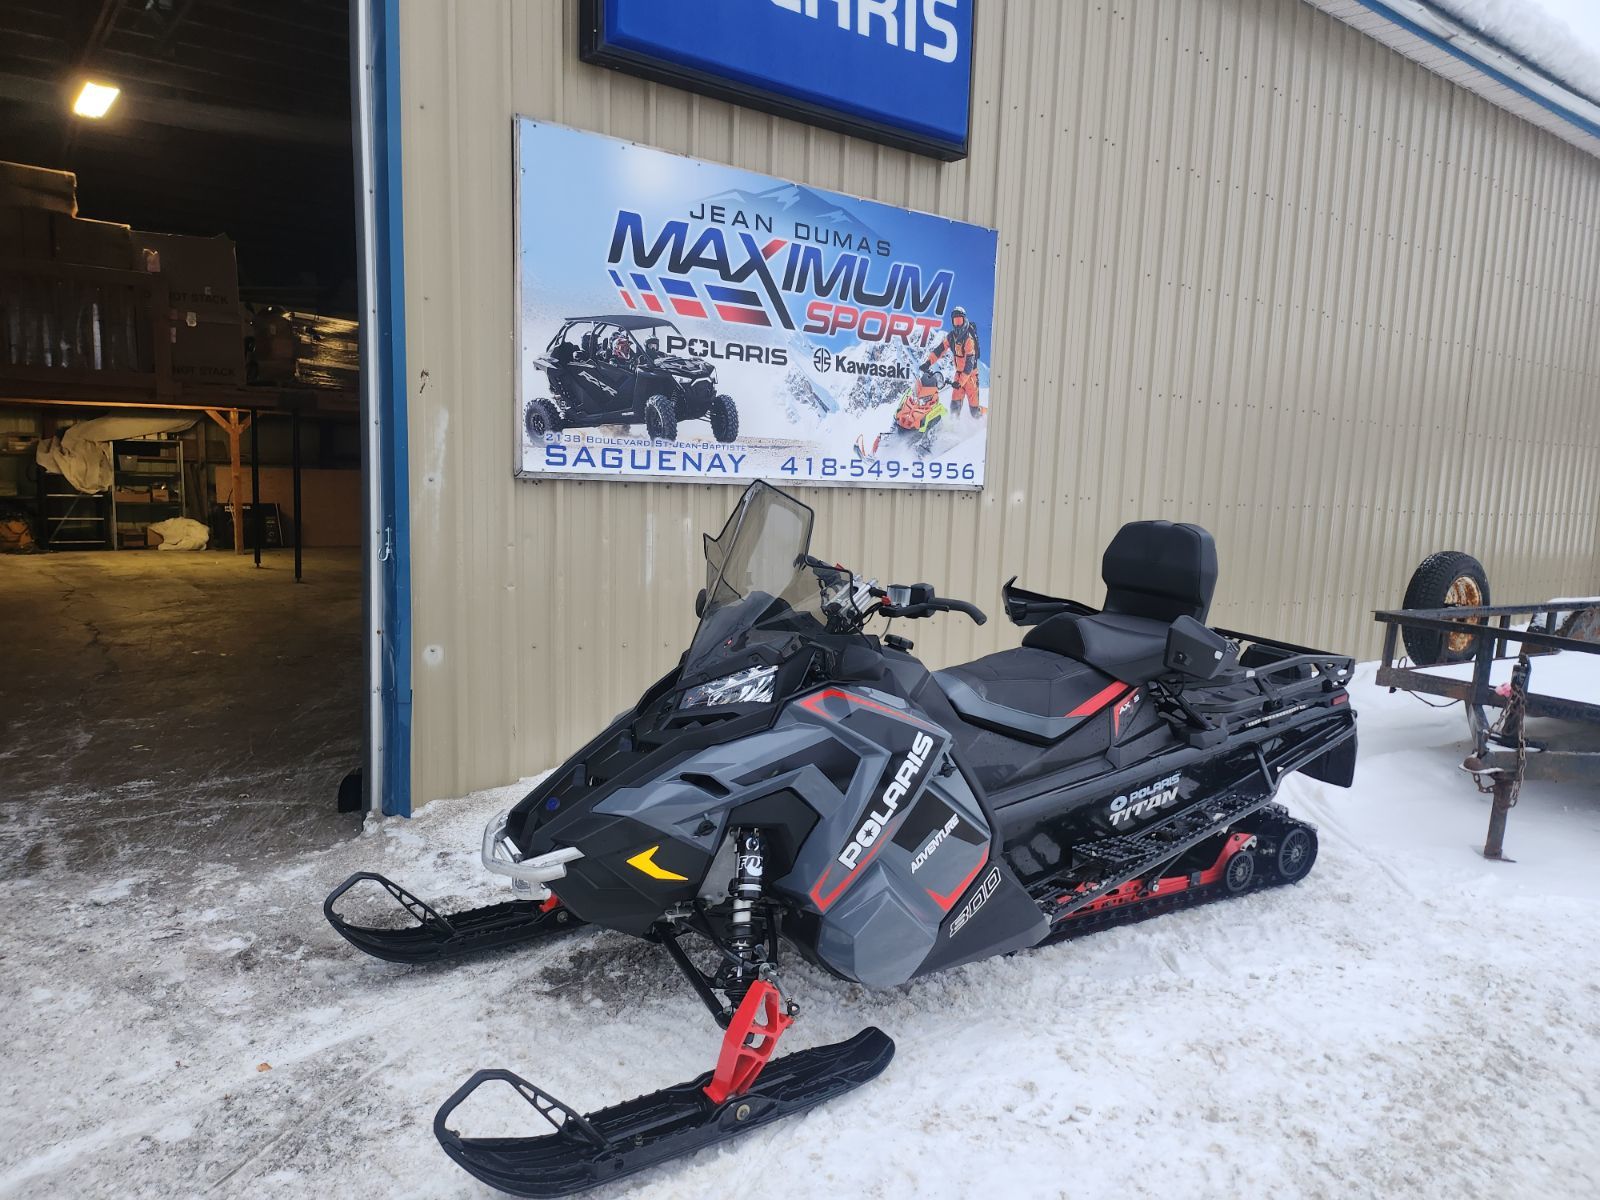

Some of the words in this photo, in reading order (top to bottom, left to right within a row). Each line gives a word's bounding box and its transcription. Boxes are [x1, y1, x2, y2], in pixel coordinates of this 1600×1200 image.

[690, 203, 772, 233] JEAN
[795, 223, 891, 256] DUMAS
[607, 210, 954, 331] MAXIMUM
[803, 301, 943, 348] SPORT
[667, 335, 788, 366] POLARIS
[835, 355, 910, 379] Kawasaki
[545, 444, 747, 474] SAGUENAY
[780, 456, 975, 480] 418-549-3956
[838, 731, 934, 871] POLARIS
[1108, 786, 1179, 826] TITAN
[1129, 772, 1182, 803] POLARIS
[911, 814, 960, 874] ADVENTURE
